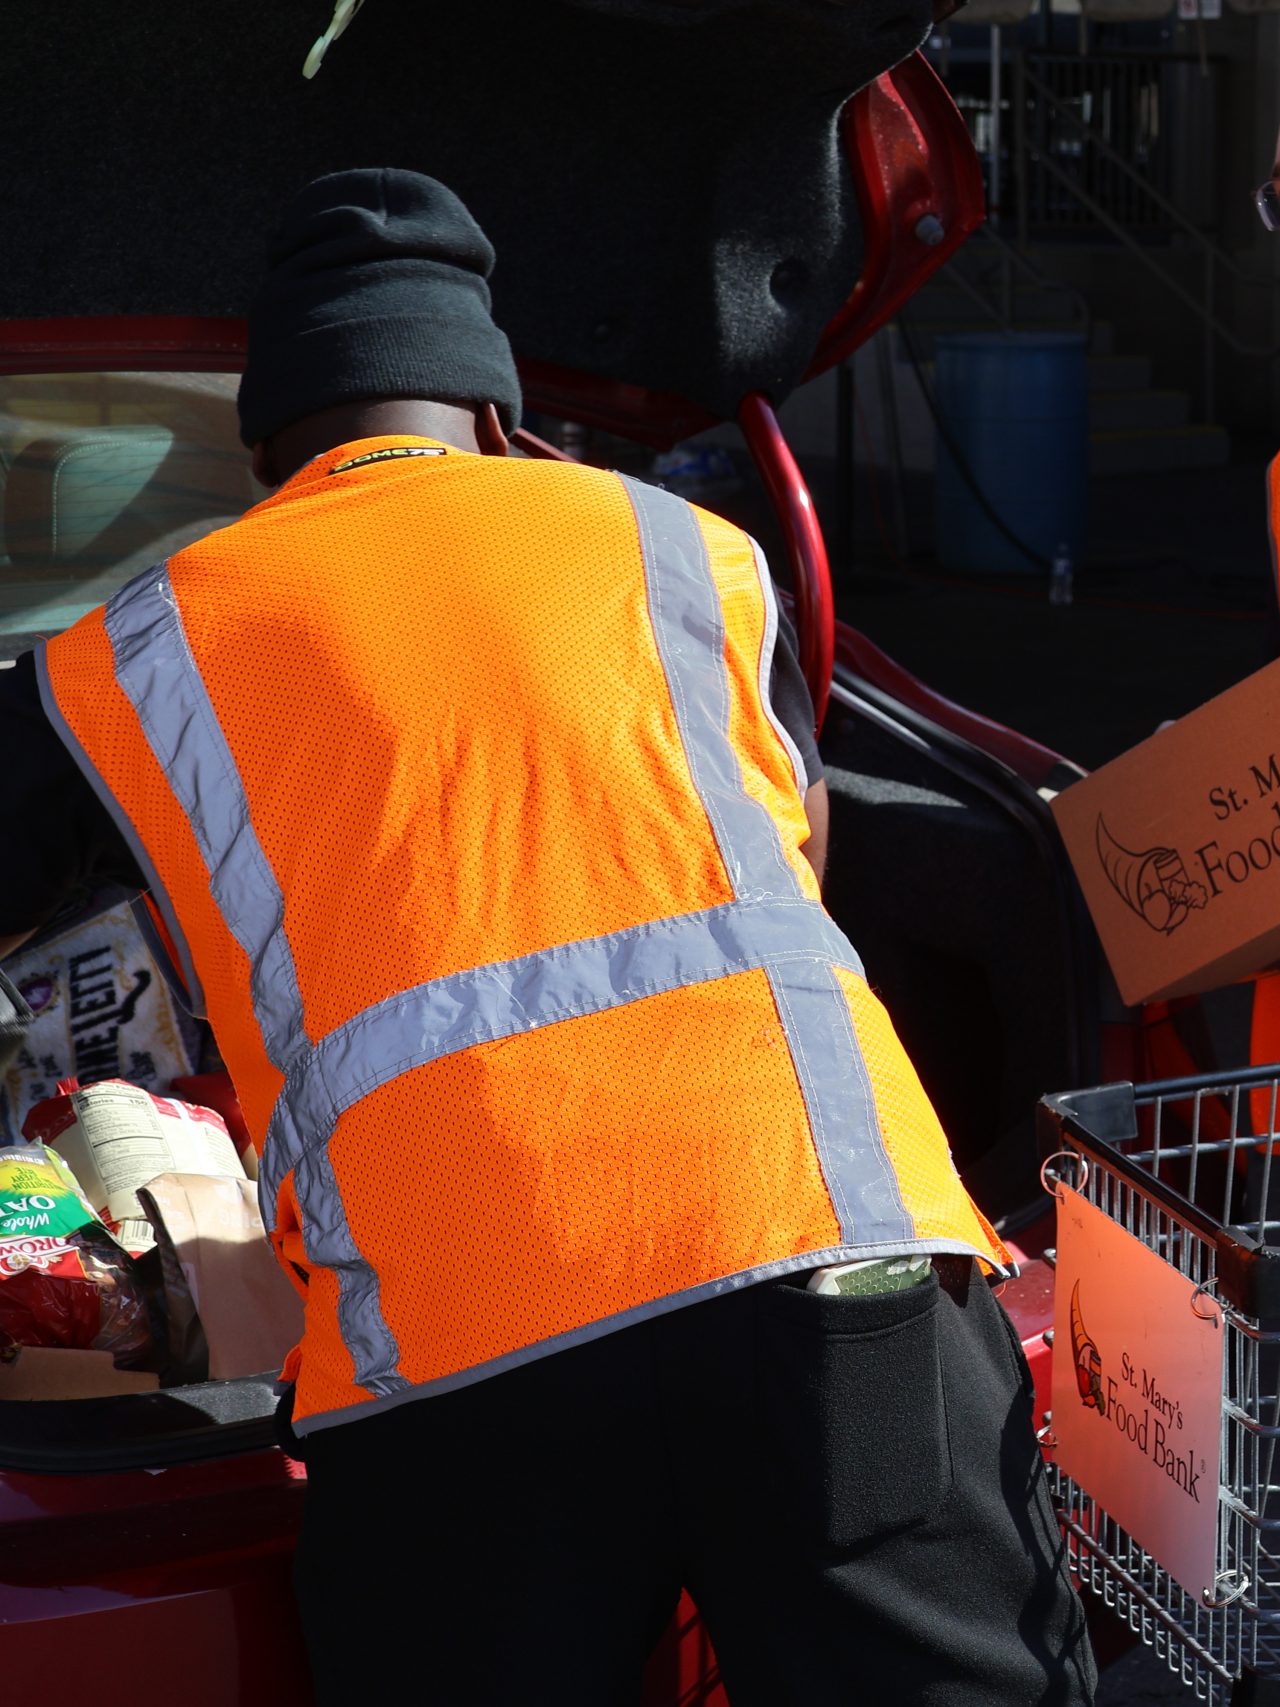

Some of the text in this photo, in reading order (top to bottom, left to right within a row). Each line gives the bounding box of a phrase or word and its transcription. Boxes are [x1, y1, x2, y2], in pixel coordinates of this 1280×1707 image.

[1208, 786, 1248, 821] St.
[2, 1212, 50, 1231] Whole
[1121, 1351, 1185, 1431] St. Mary's
[1105, 1375, 1201, 1505] Food Bank
